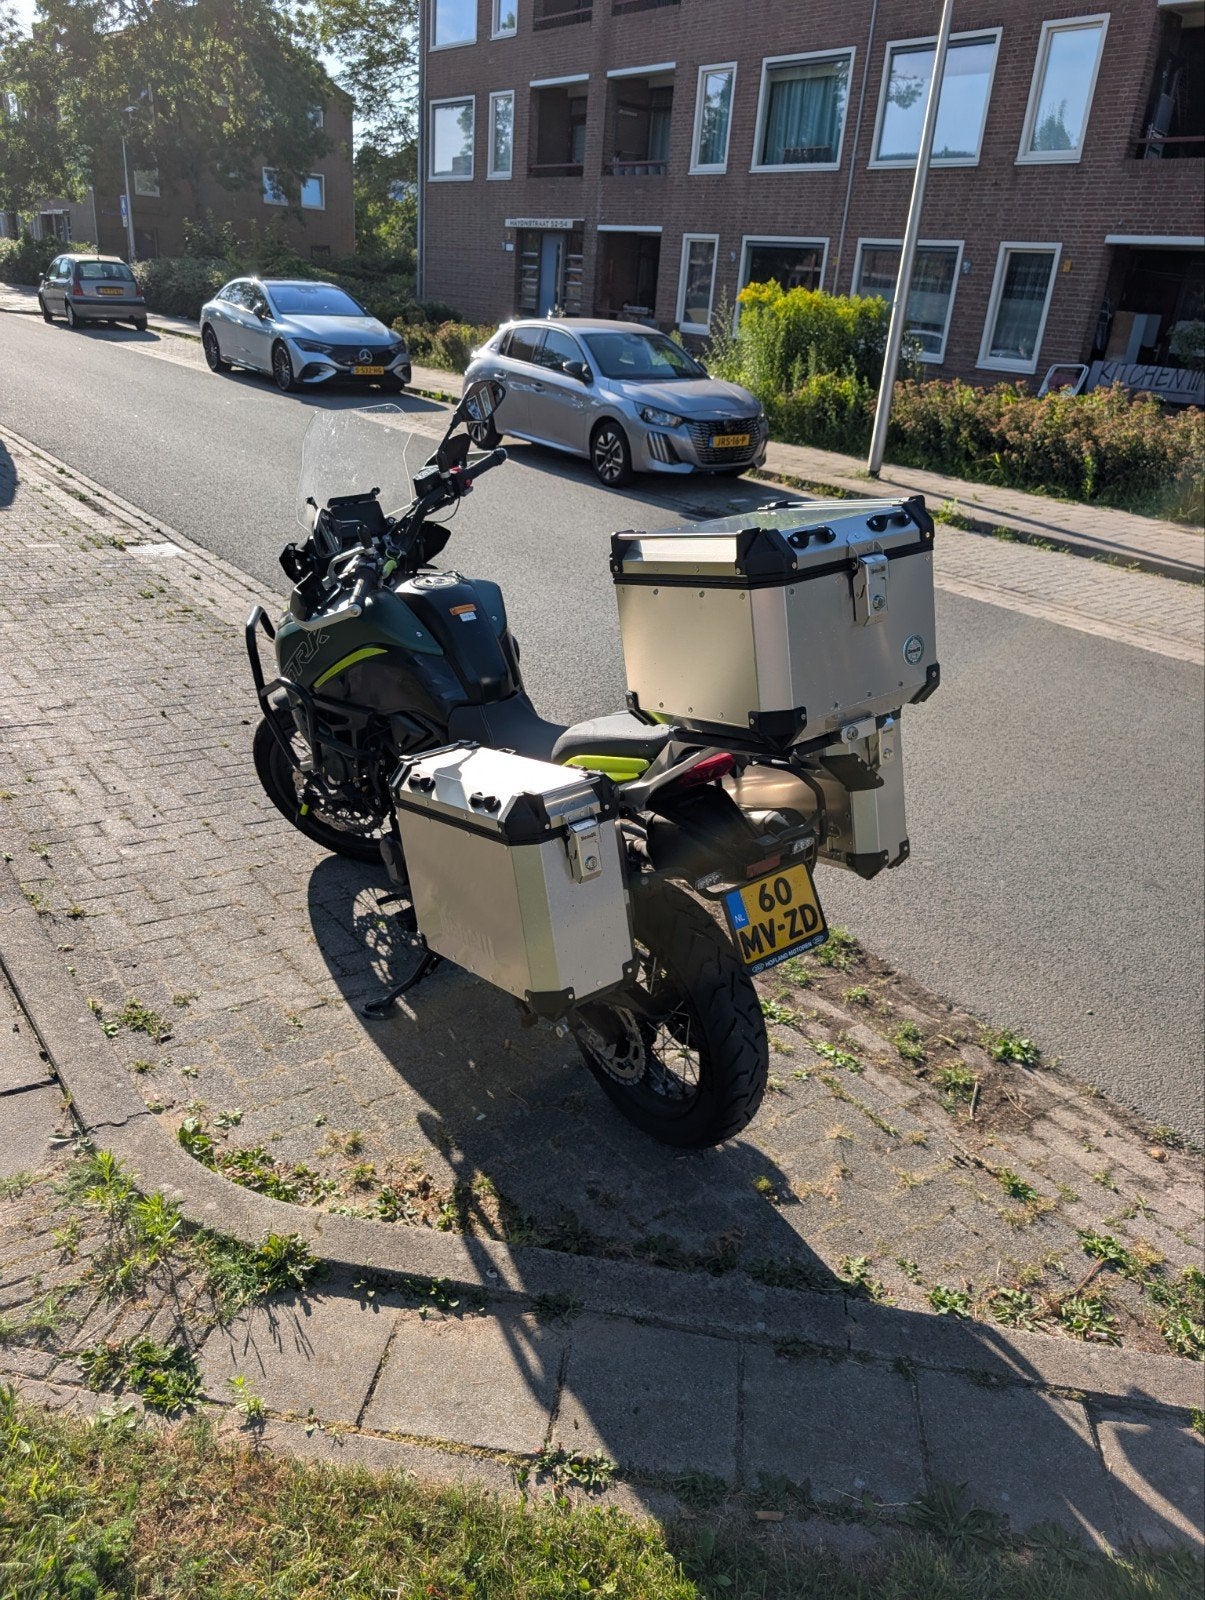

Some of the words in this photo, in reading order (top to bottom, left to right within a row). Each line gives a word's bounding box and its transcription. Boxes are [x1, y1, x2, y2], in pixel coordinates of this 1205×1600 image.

[1097, 361, 1184, 390] KITCHEN
[758, 876, 793, 913] 60
[734, 914, 746, 924] NL
[738, 903, 819, 960] MV-ZD
[765, 950, 789, 968] HOFLAND
